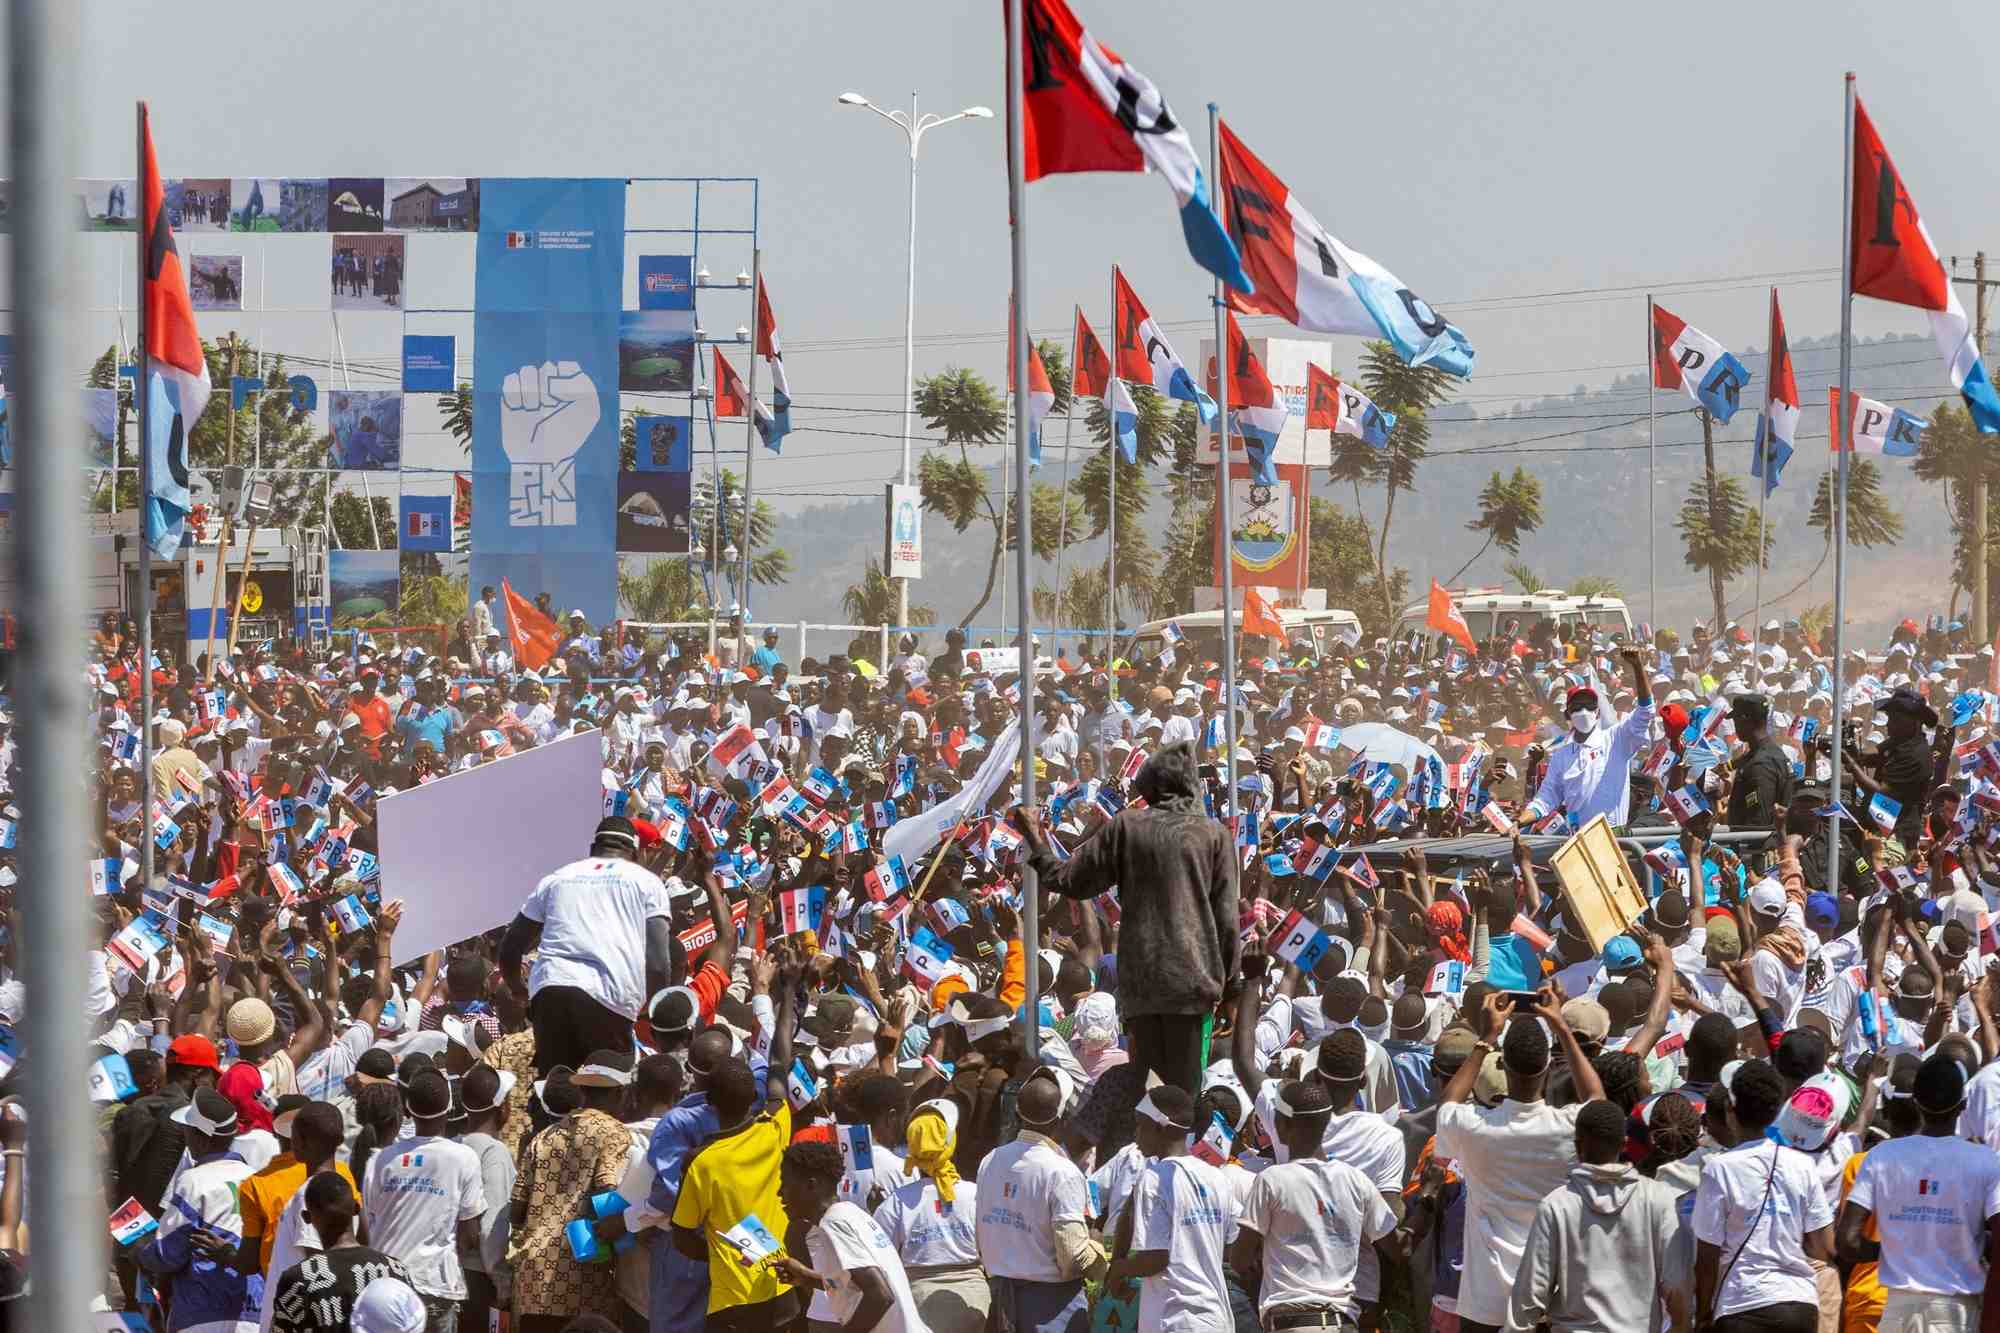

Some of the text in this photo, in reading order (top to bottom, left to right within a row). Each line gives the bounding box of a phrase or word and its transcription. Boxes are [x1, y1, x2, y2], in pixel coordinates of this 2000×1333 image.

[1861, 408, 1918, 444] PR
[94, 872, 118, 884] PR
[870, 866, 903, 892] FPR
[786, 901, 823, 916] FPR
[915, 939, 938, 970] PR
[1288, 932, 1321, 959] PR
[1436, 971, 1462, 983] PR
[841, 1140, 867, 1153] PR
[738, 1227, 768, 1248] PR
